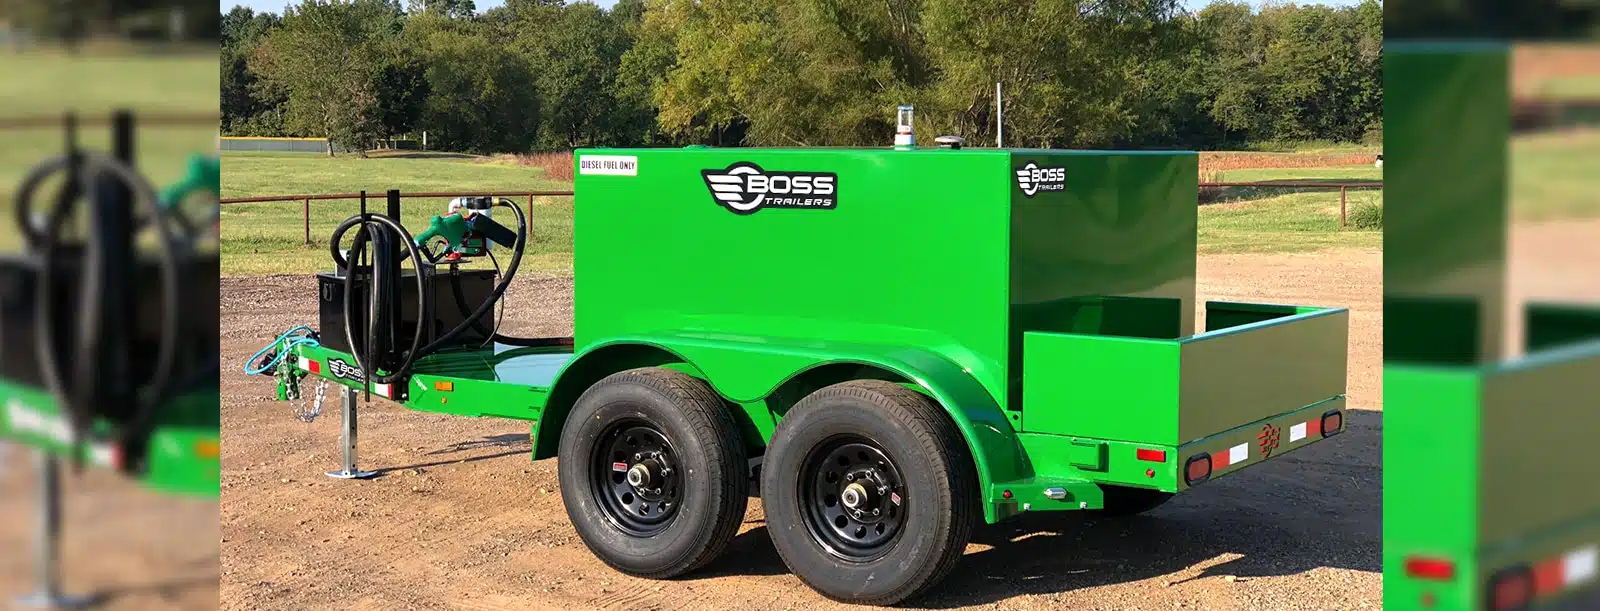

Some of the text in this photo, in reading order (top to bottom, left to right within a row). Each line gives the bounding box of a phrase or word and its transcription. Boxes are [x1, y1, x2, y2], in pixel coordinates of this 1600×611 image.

[581, 160, 635, 170] DIESEL FUEL ONLY
[1031, 168, 1065, 183] BOSS
[747, 175, 834, 195] BOSS
[764, 197, 833, 206] TRAILERS
